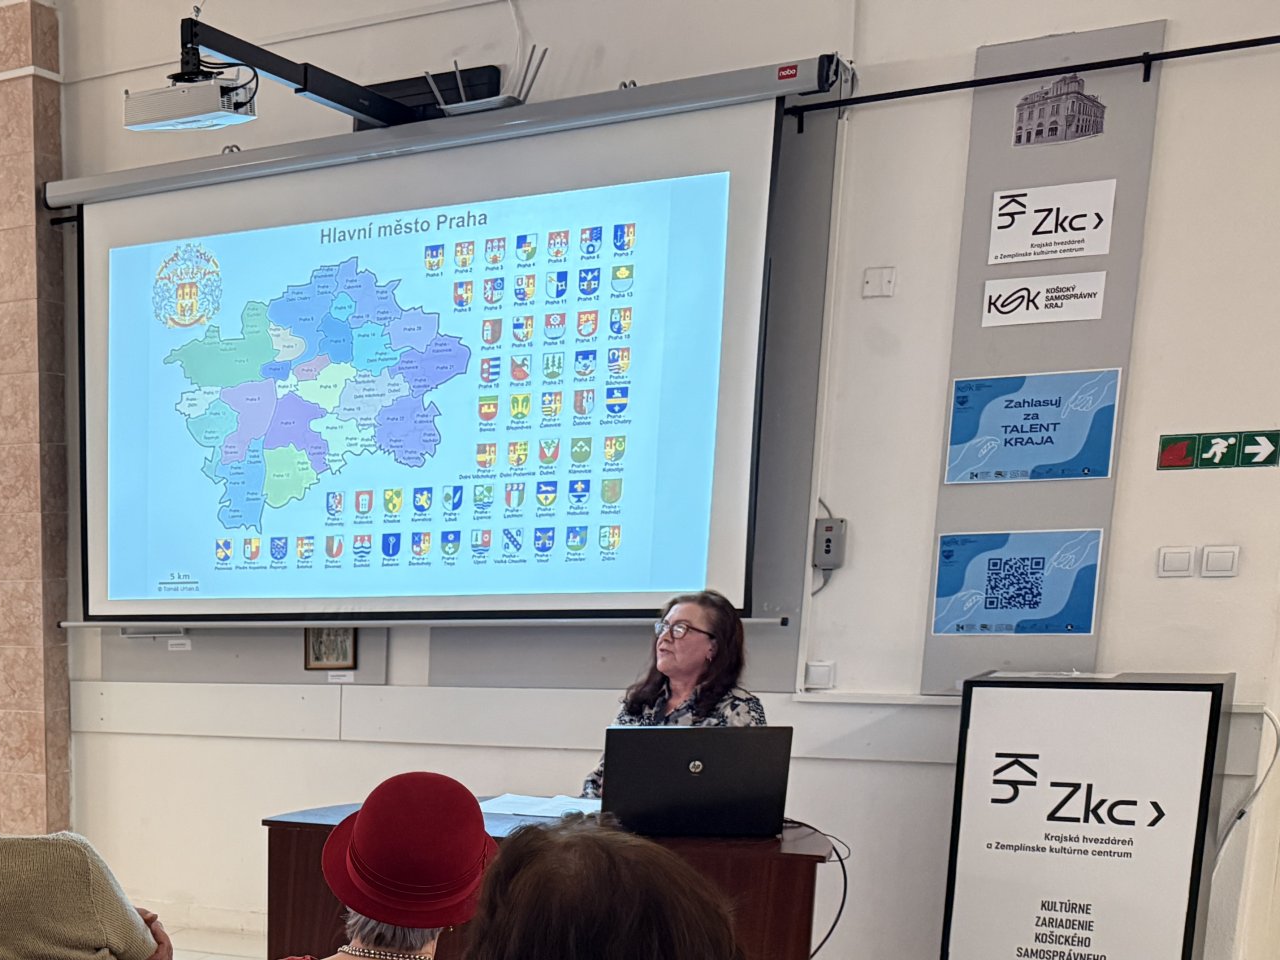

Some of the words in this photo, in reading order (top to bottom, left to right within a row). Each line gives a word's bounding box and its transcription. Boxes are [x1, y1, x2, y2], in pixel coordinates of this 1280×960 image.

[320, 222, 373, 245] Hlavní
[378, 218, 431, 238] město
[436, 210, 488, 231] Praha
[1032, 207, 1088, 236] Zkc
[1030, 241, 1052, 249] Krajská
[1053, 237, 1085, 247] hvezdáreň
[999, 252, 1032, 260] Zemplínske
[1033, 248, 1058, 257] kultúrne
[1059, 246, 1085, 254] centrum
[1045, 284, 1077, 294] KOŠICKÝ
[1044, 291, 1098, 302] SAMOSPRÁVNY
[1044, 301, 1064, 309] KRAJ
[1004, 396, 1062, 410] Zahlasuj
[1023, 412, 1040, 421] za
[1001, 422, 1061, 435] TALENT
[1004, 436, 1055, 447] KRAJA
[177, 572, 190, 580] km
[1046, 782, 1138, 827] Zkc
[1043, 831, 1080, 846] Krajská
[1082, 834, 1134, 847] hvezdáreň
[986, 842, 993, 850] a
[994, 841, 1047, 857] Zemplínske
[1049, 844, 1089, 858] kultúrne
[1090, 848, 1133, 859] centrum
[1040, 899, 1092, 916] KULTÚRNE
[1034, 916, 1095, 932] ZARIADENIE
[1033, 930, 1091, 948] KOŠICKÉHO
